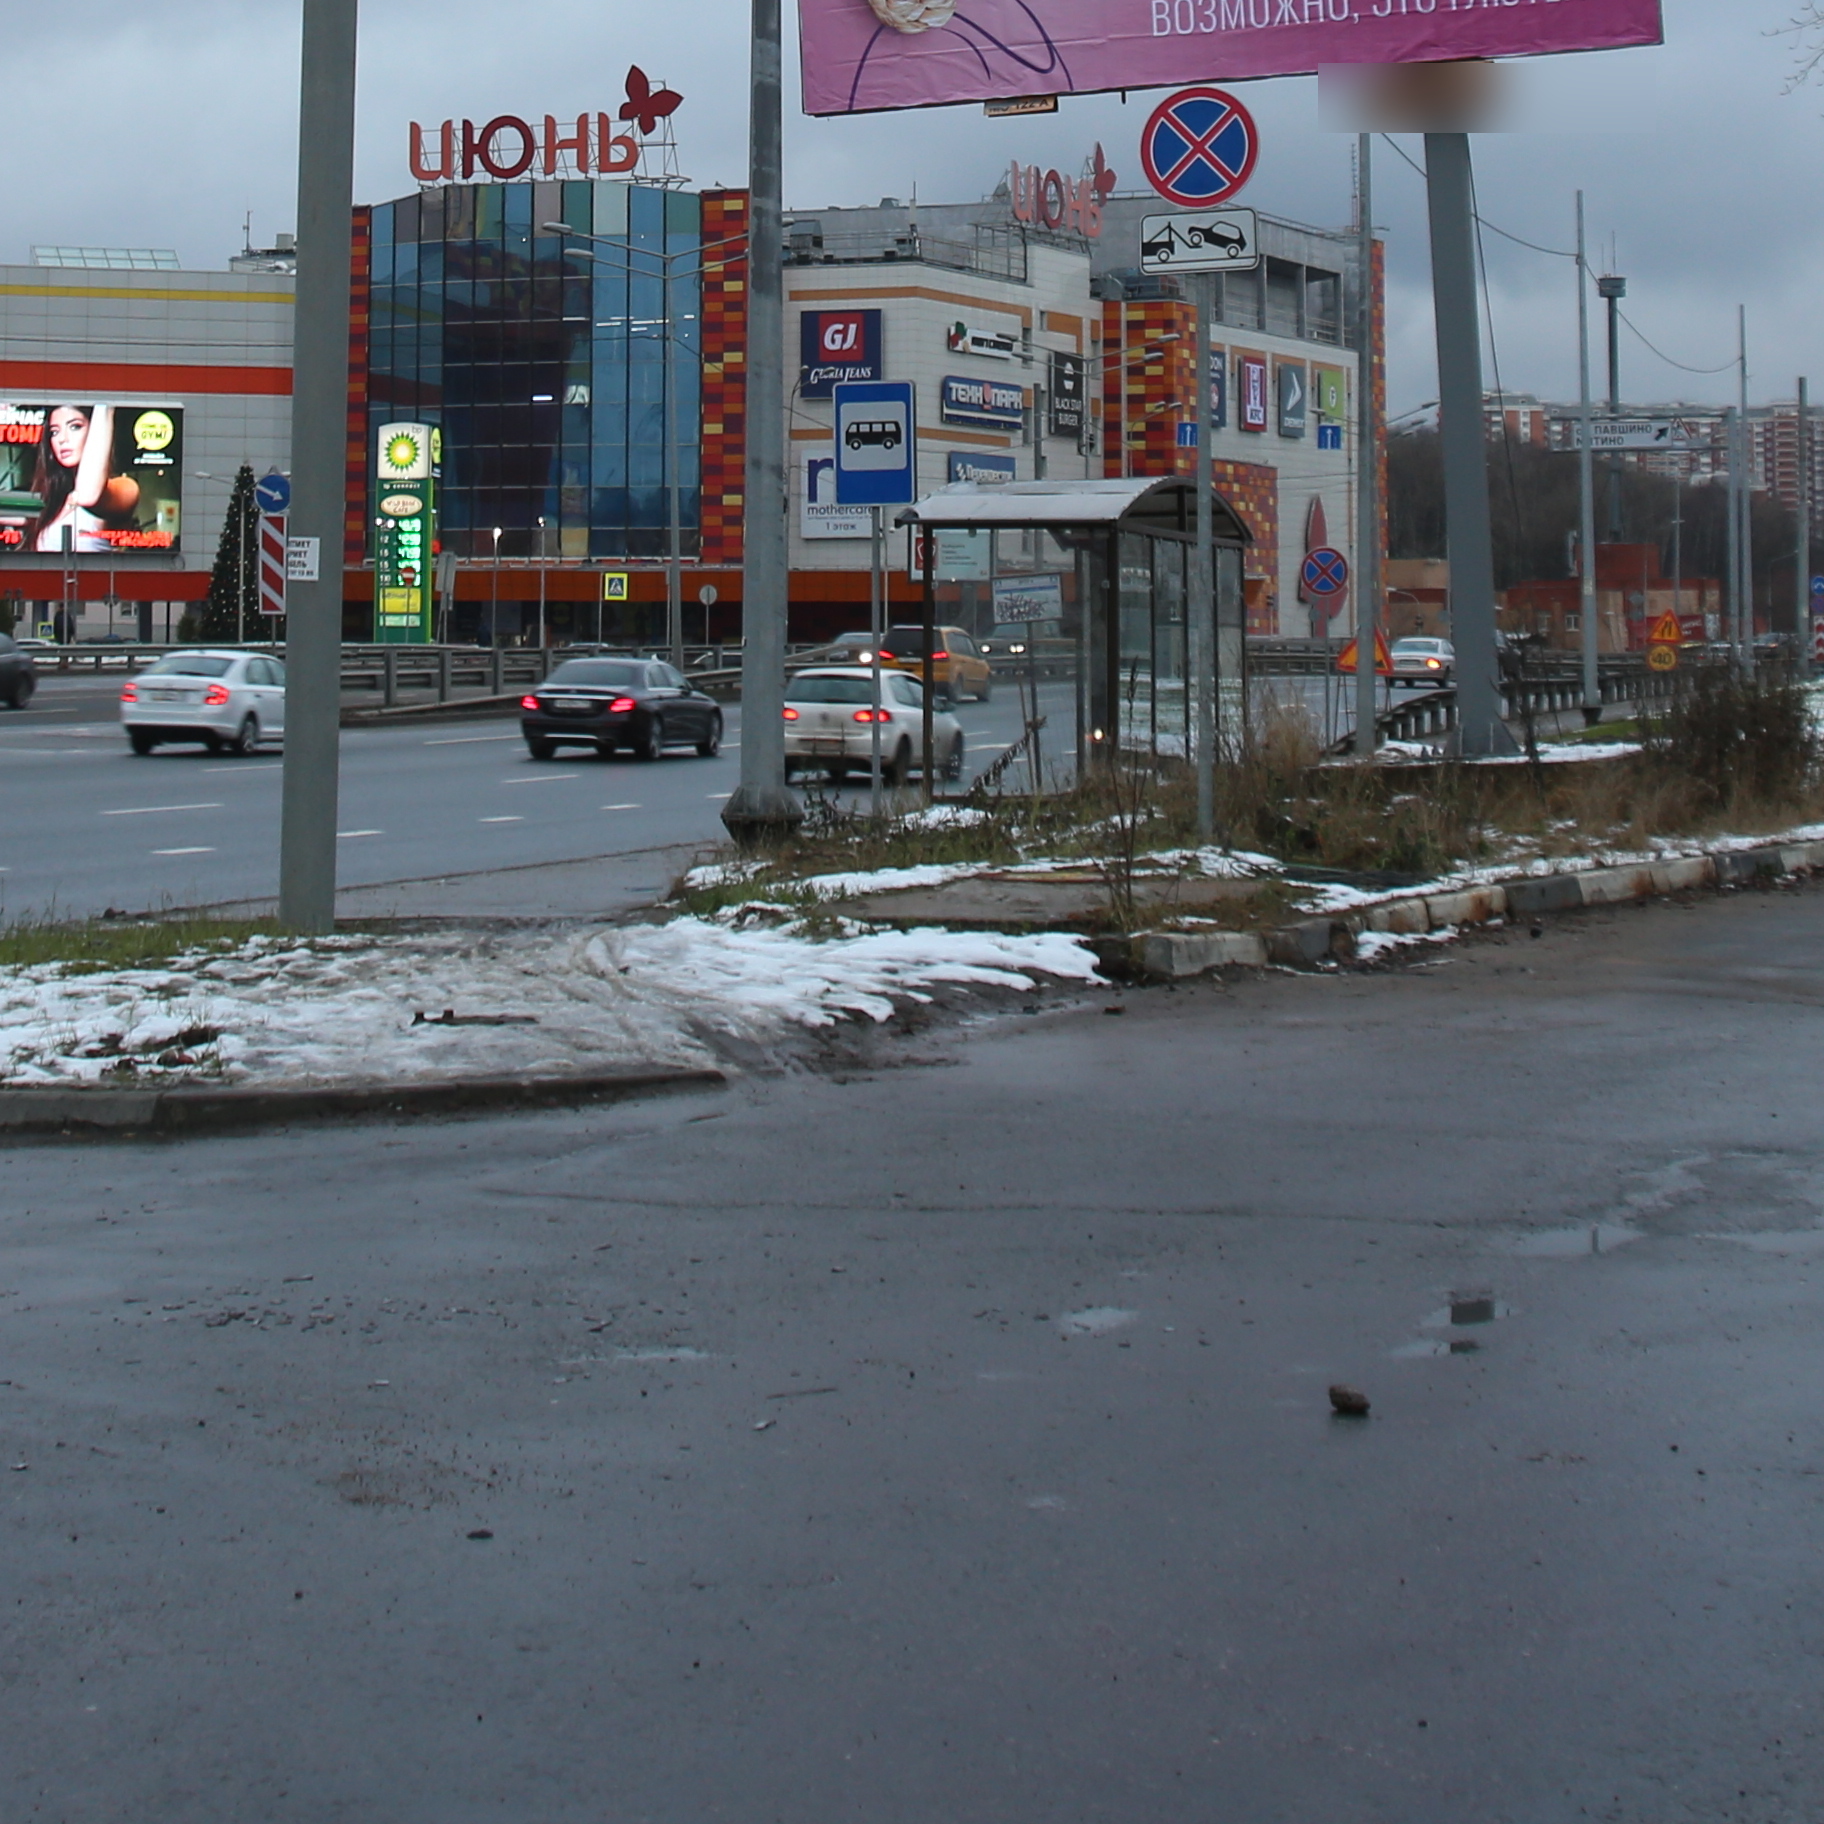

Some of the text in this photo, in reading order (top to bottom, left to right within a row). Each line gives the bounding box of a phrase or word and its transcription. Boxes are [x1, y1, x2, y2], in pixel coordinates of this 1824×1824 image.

[409, 111, 639, 181] ИЮНЬ
[1010, 159, 1103, 238] ИЮНЬ
[823, 323, 858, 352] GJ
[412, 427, 423, 435] bp
[1594, 424, 1653, 435] ПАВШИНО
[807, 504, 873, 515] mothercare
